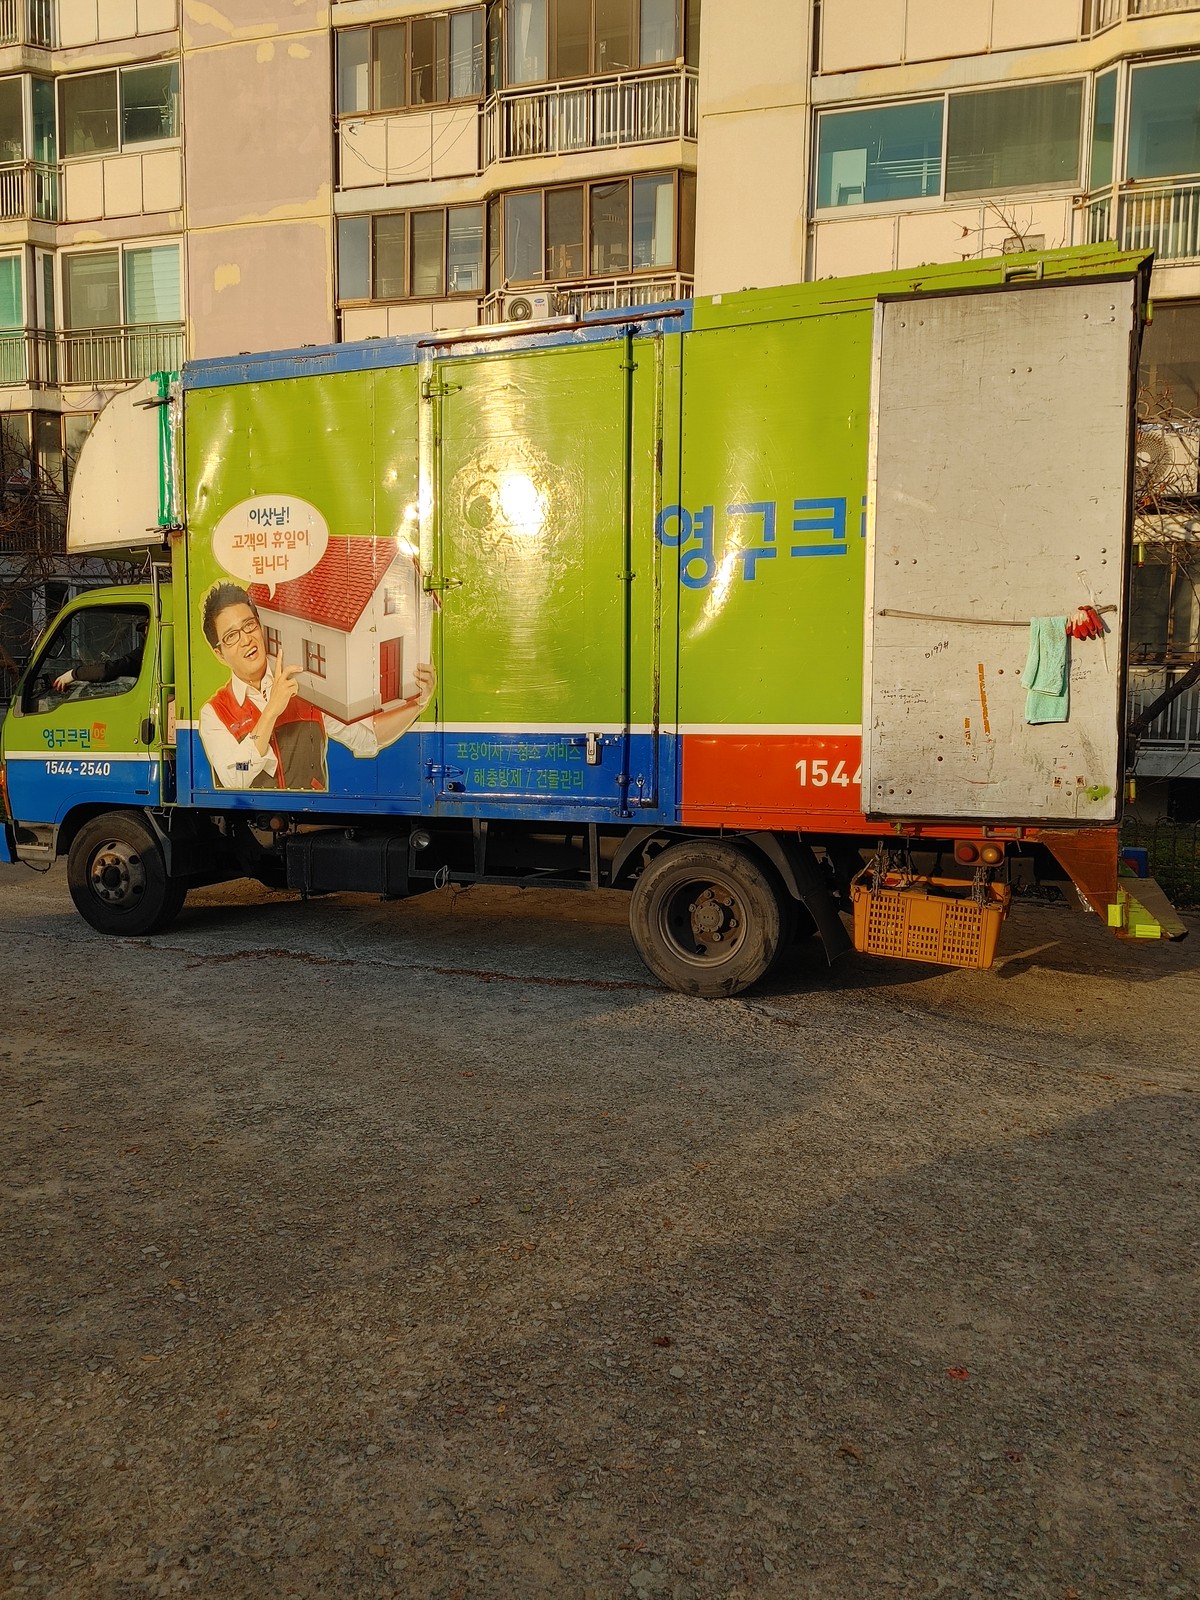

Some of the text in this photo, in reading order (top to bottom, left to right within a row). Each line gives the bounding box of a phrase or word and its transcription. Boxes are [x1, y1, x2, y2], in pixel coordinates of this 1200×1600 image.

[249, 506, 290, 527] 이삿날!
[231, 529, 309, 552] 고객의 휴일이
[656, 495, 867, 589] 영구크
[251, 554, 289, 575] 됩니다
[42, 728, 91, 749] 영구크린
[457, 741, 504, 761] 포장이사
[517, 741, 542, 761] 청소
[544, 741, 581, 762] 서비스
[45, 761, 111, 776] 1544-2540
[473, 768, 522, 788] 해충방제
[536, 769, 584, 791] 건물관리
